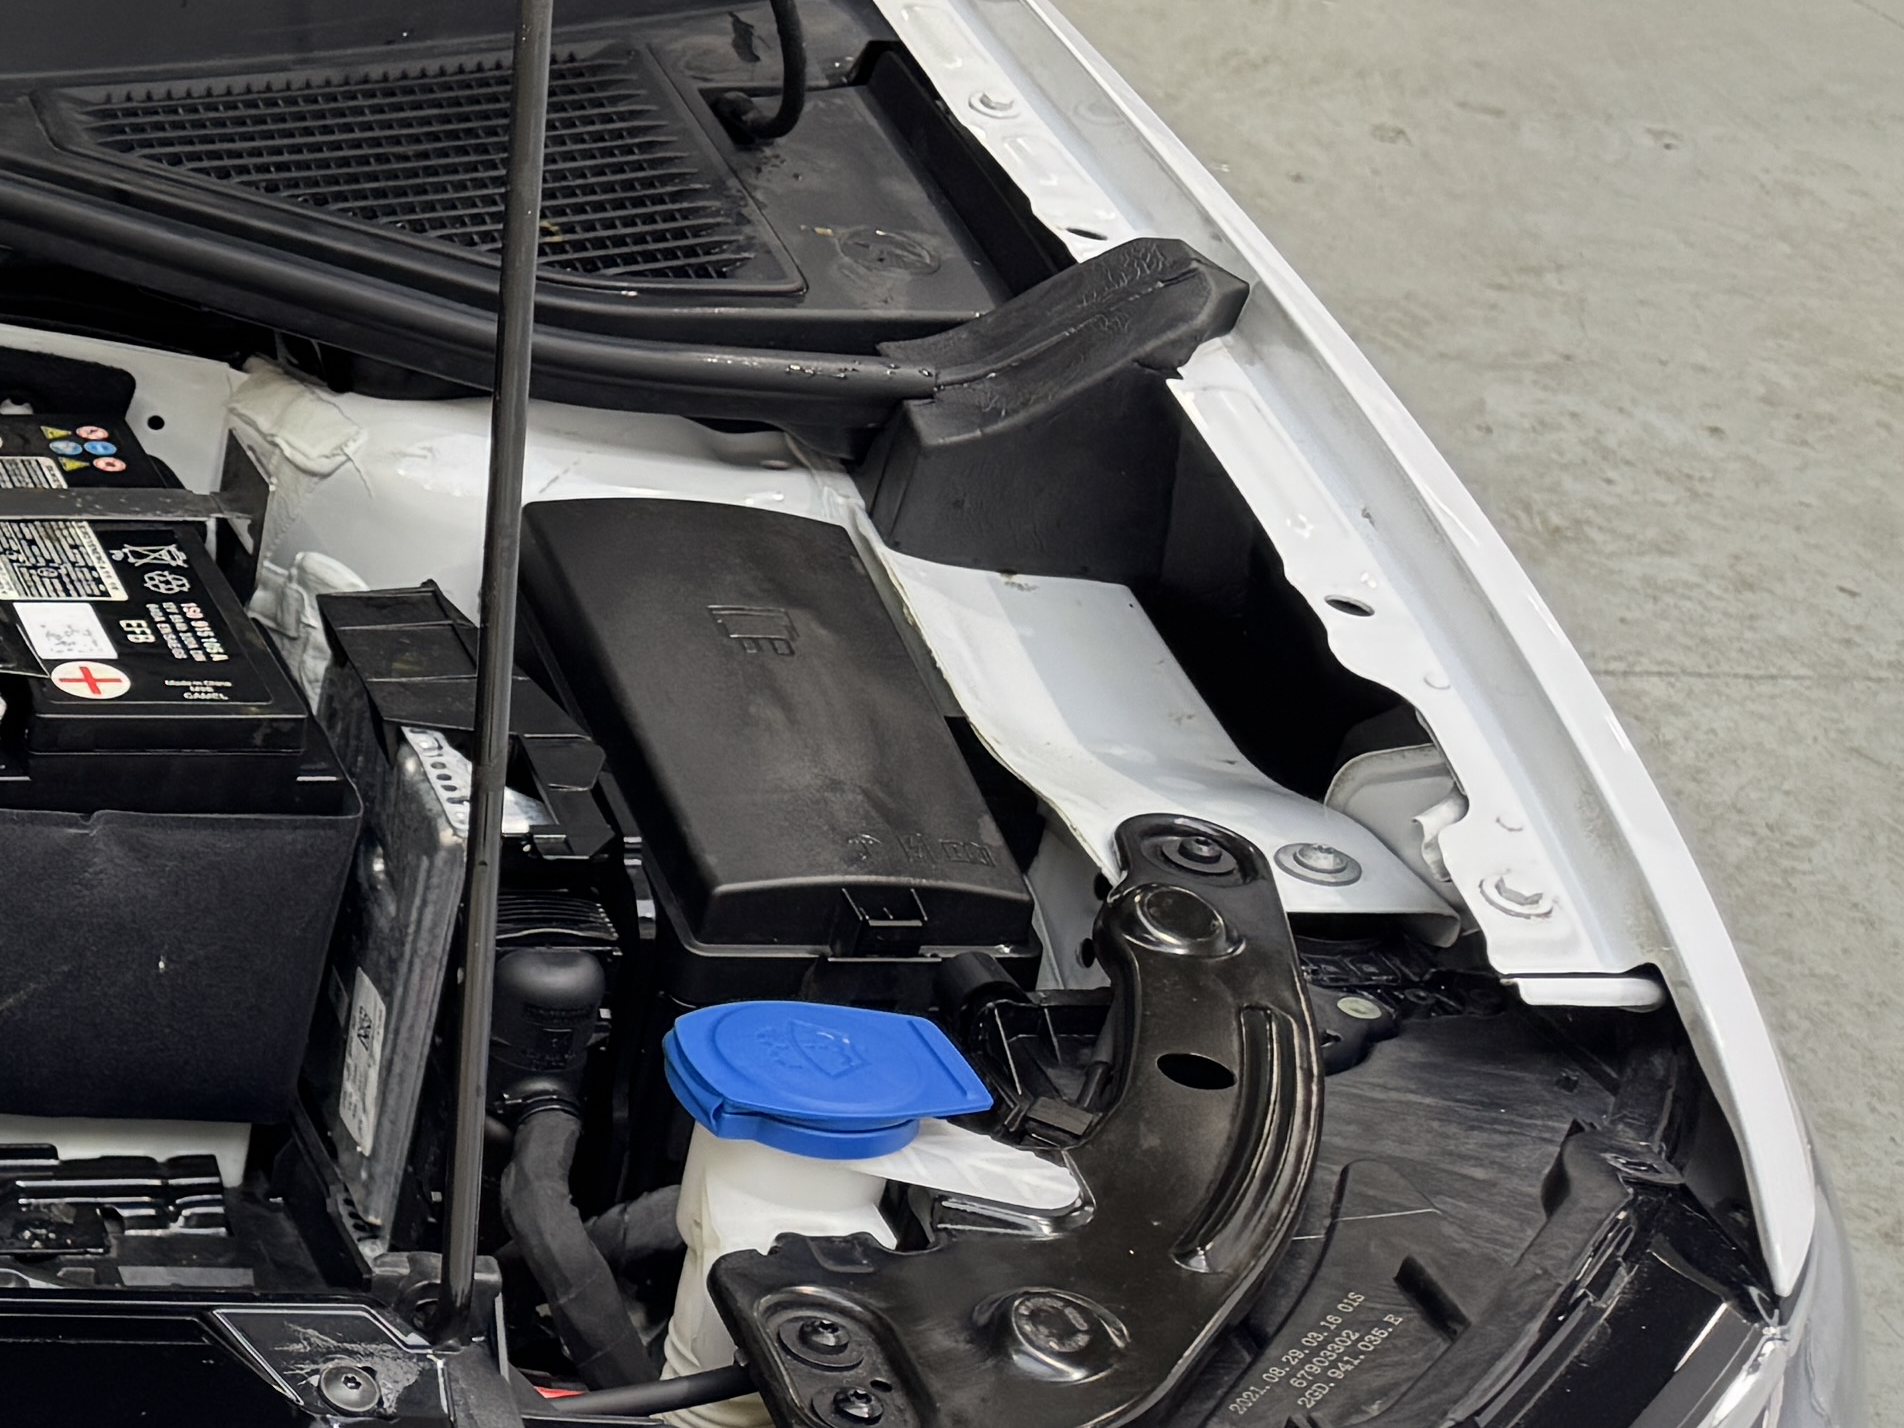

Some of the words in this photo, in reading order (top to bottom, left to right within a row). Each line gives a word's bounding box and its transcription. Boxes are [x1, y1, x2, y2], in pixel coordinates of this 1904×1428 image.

[119, 619, 156, 643] EFB
[1336, 1290, 1366, 1313] 01S
[1288, 1327, 1361, 1390] 67903302
[1296, 1312, 1404, 1411] 2GD.941.035.E
